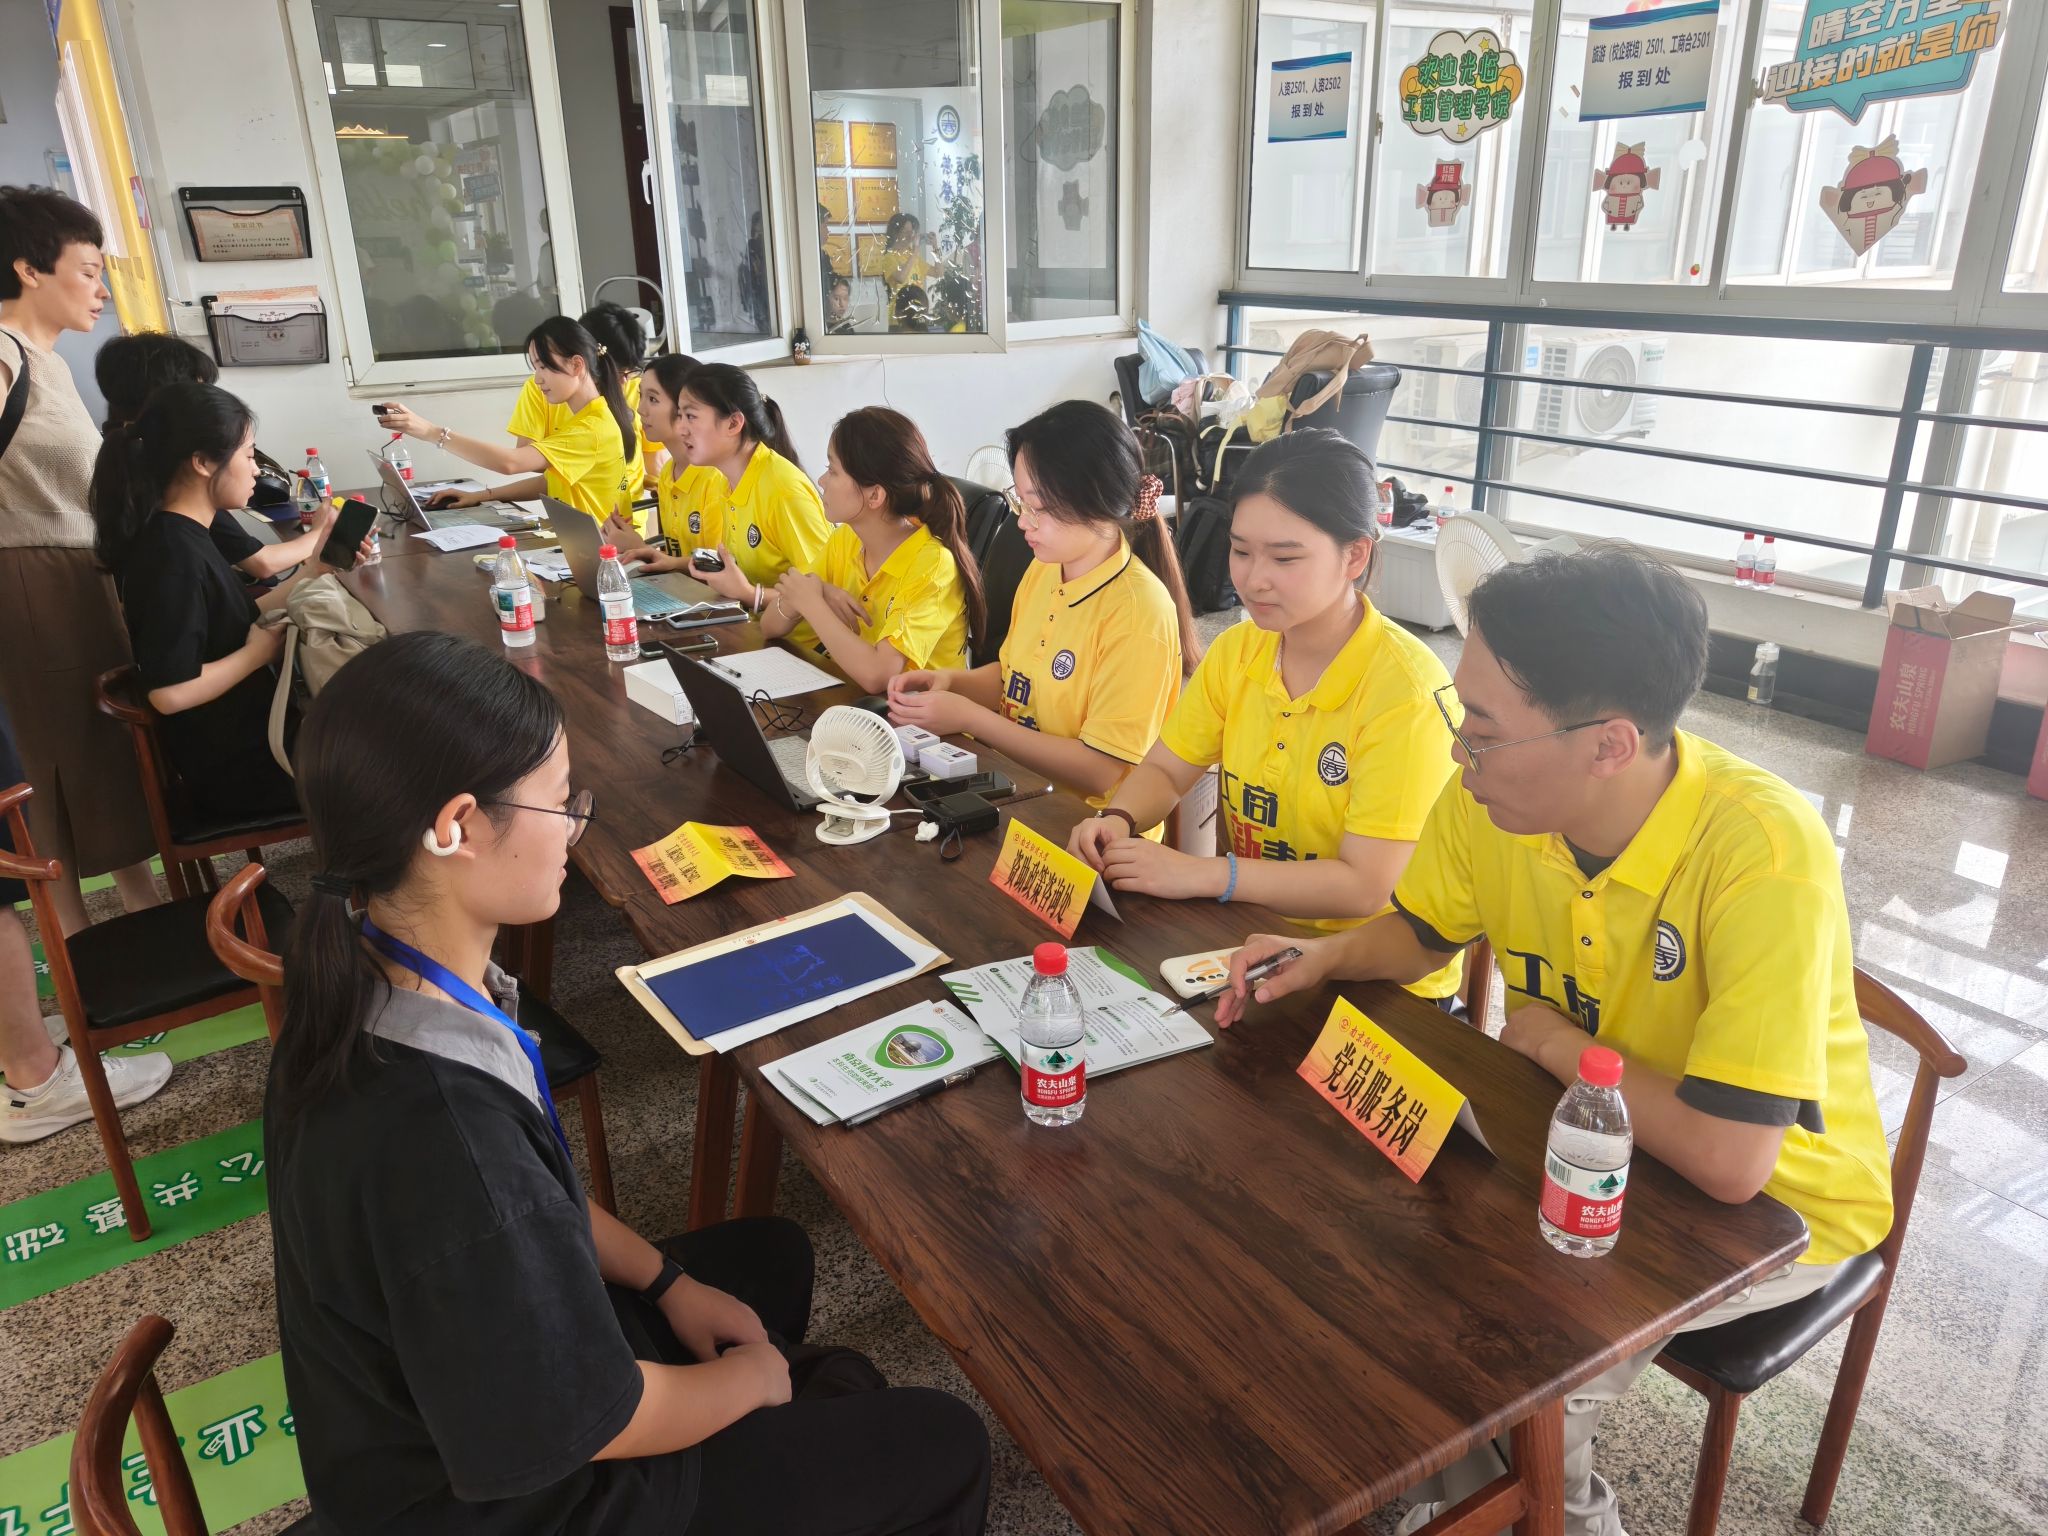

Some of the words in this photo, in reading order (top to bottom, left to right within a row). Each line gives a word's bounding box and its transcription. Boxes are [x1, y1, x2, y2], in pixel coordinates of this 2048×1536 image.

[1417, 49, 1500, 89] 欢迎光临
[1764, 12, 2000, 101] 迎接的就是你
[1618, 66, 1671, 90] 报到处
[1290, 102, 1325, 119] 报到处
[1402, 86, 1512, 122] 工商管理学院
[1003, 848, 1075, 925] 资助政策咨询处
[841, 1052, 894, 1088] 南京财经大学
[1036, 1075, 1077, 1089] 农夫山泉
[1320, 1041, 1428, 1157] 党员服务岗
[1580, 1216, 1606, 1224] NONGFU
